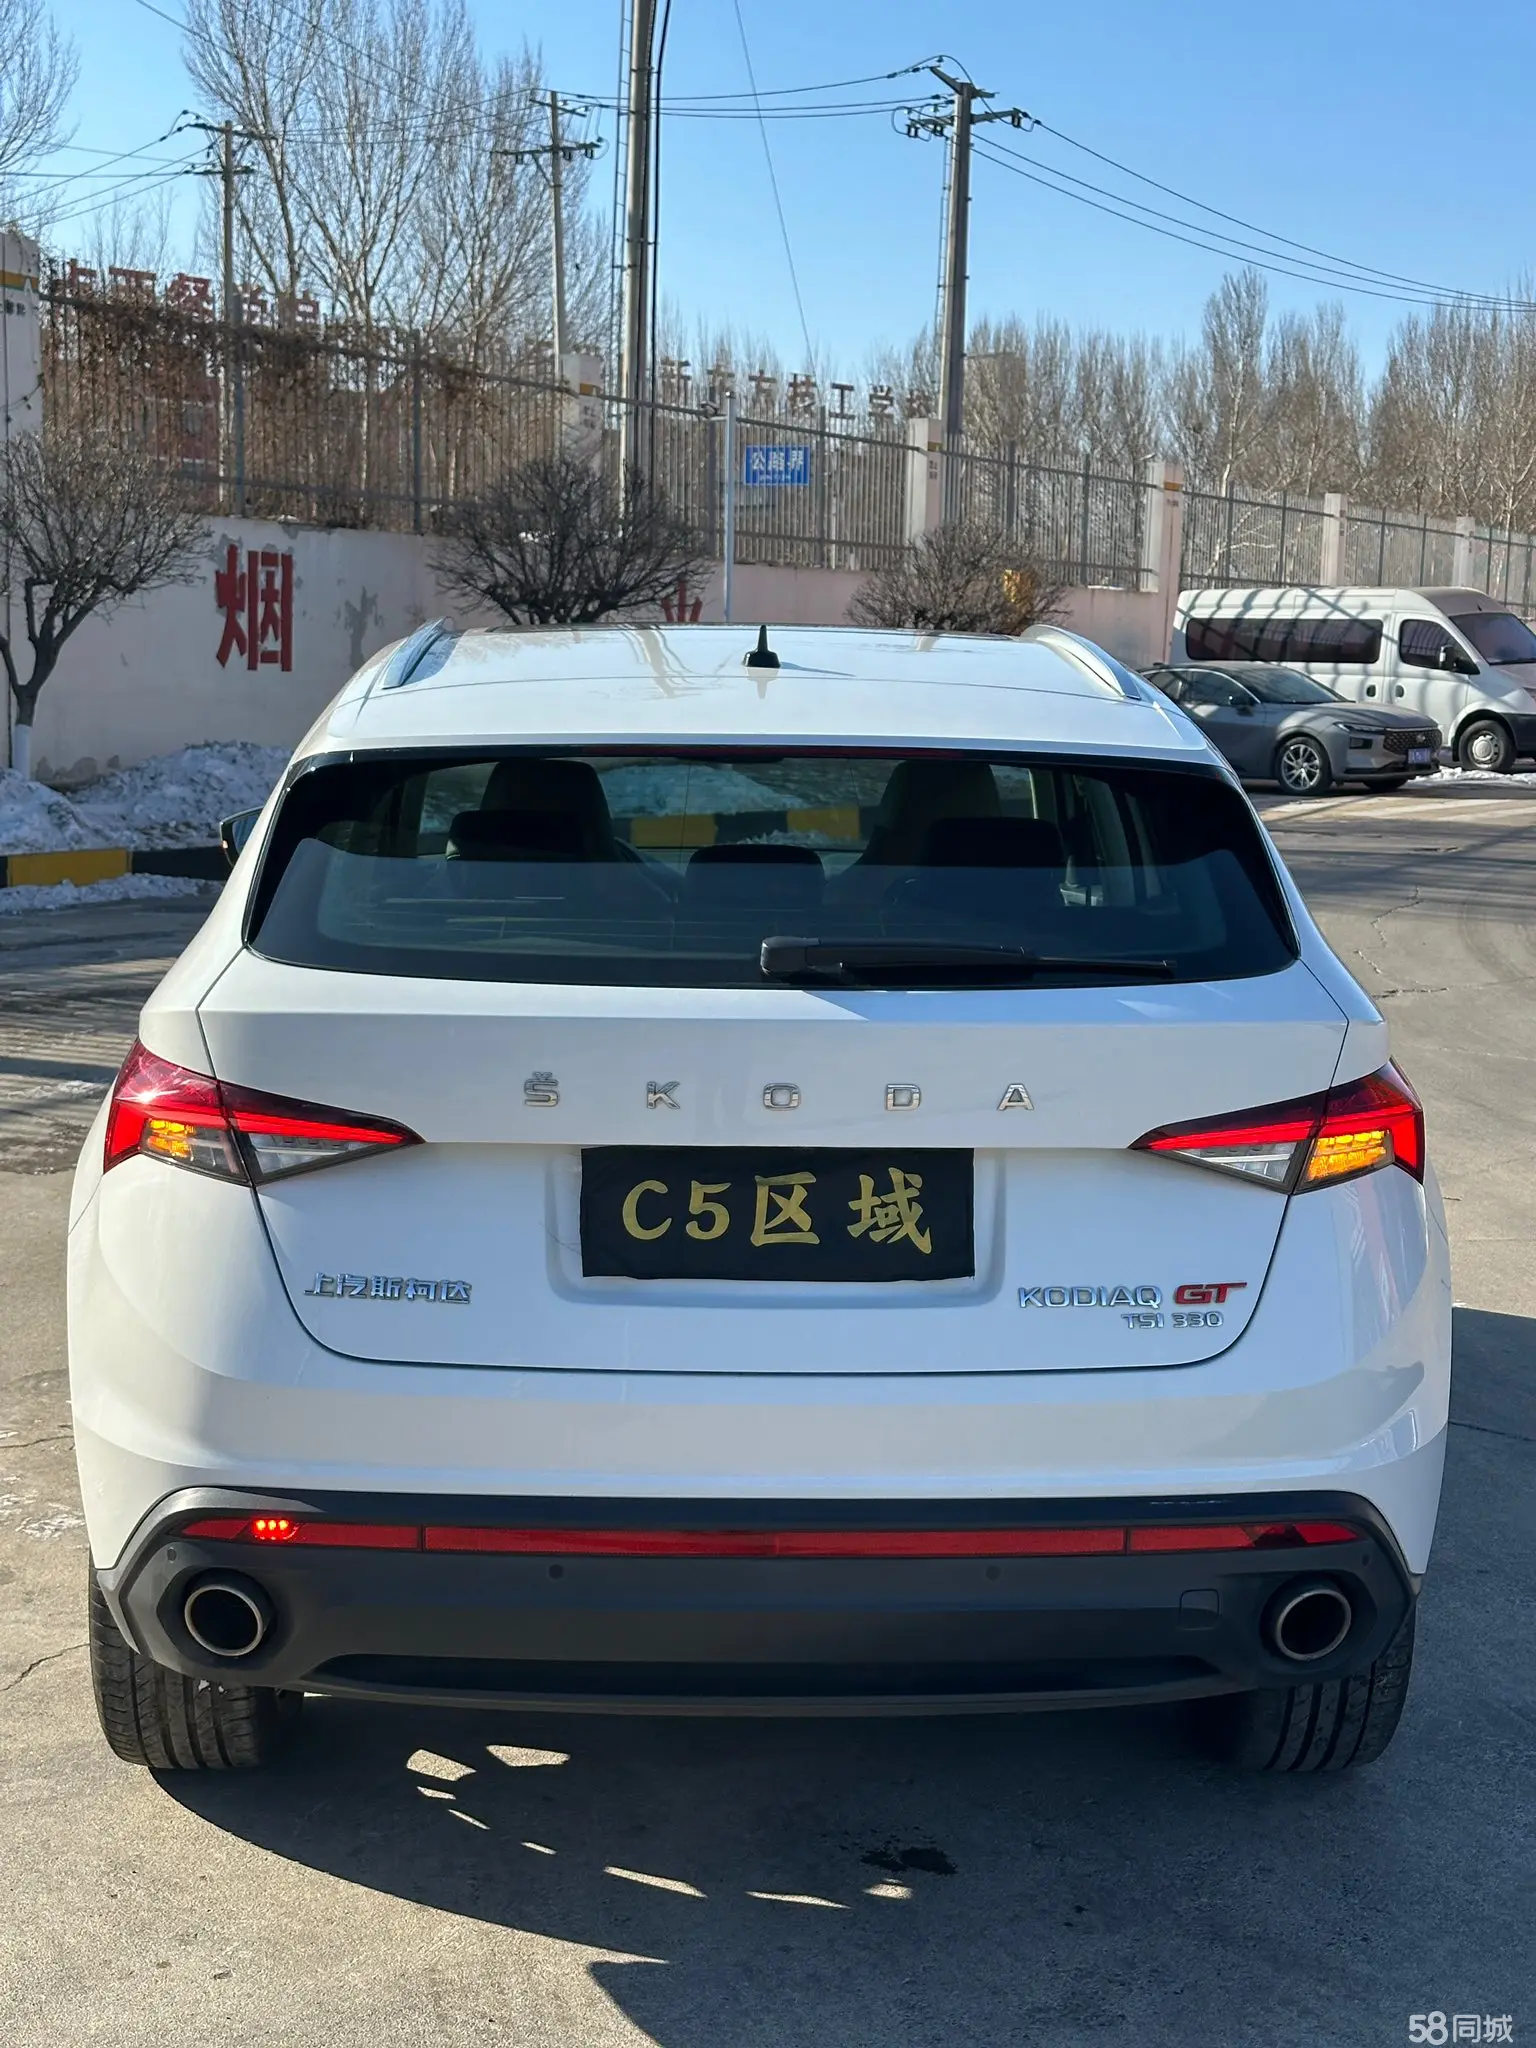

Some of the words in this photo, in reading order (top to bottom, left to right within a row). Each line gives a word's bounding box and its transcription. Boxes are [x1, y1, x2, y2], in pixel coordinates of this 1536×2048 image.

[215, 543, 294, 671] 烟
[523, 1071, 1035, 1112] ŠKODA
[622, 1167, 932, 1254] C5区域
[304, 1272, 472, 1304] 上汽斯柯达
[1018, 1285, 1163, 1309] KODIAQ
[1174, 1281, 1248, 1304] GT
[1121, 1312, 1165, 1329] TSI
[1171, 1311, 1225, 1328] 330
